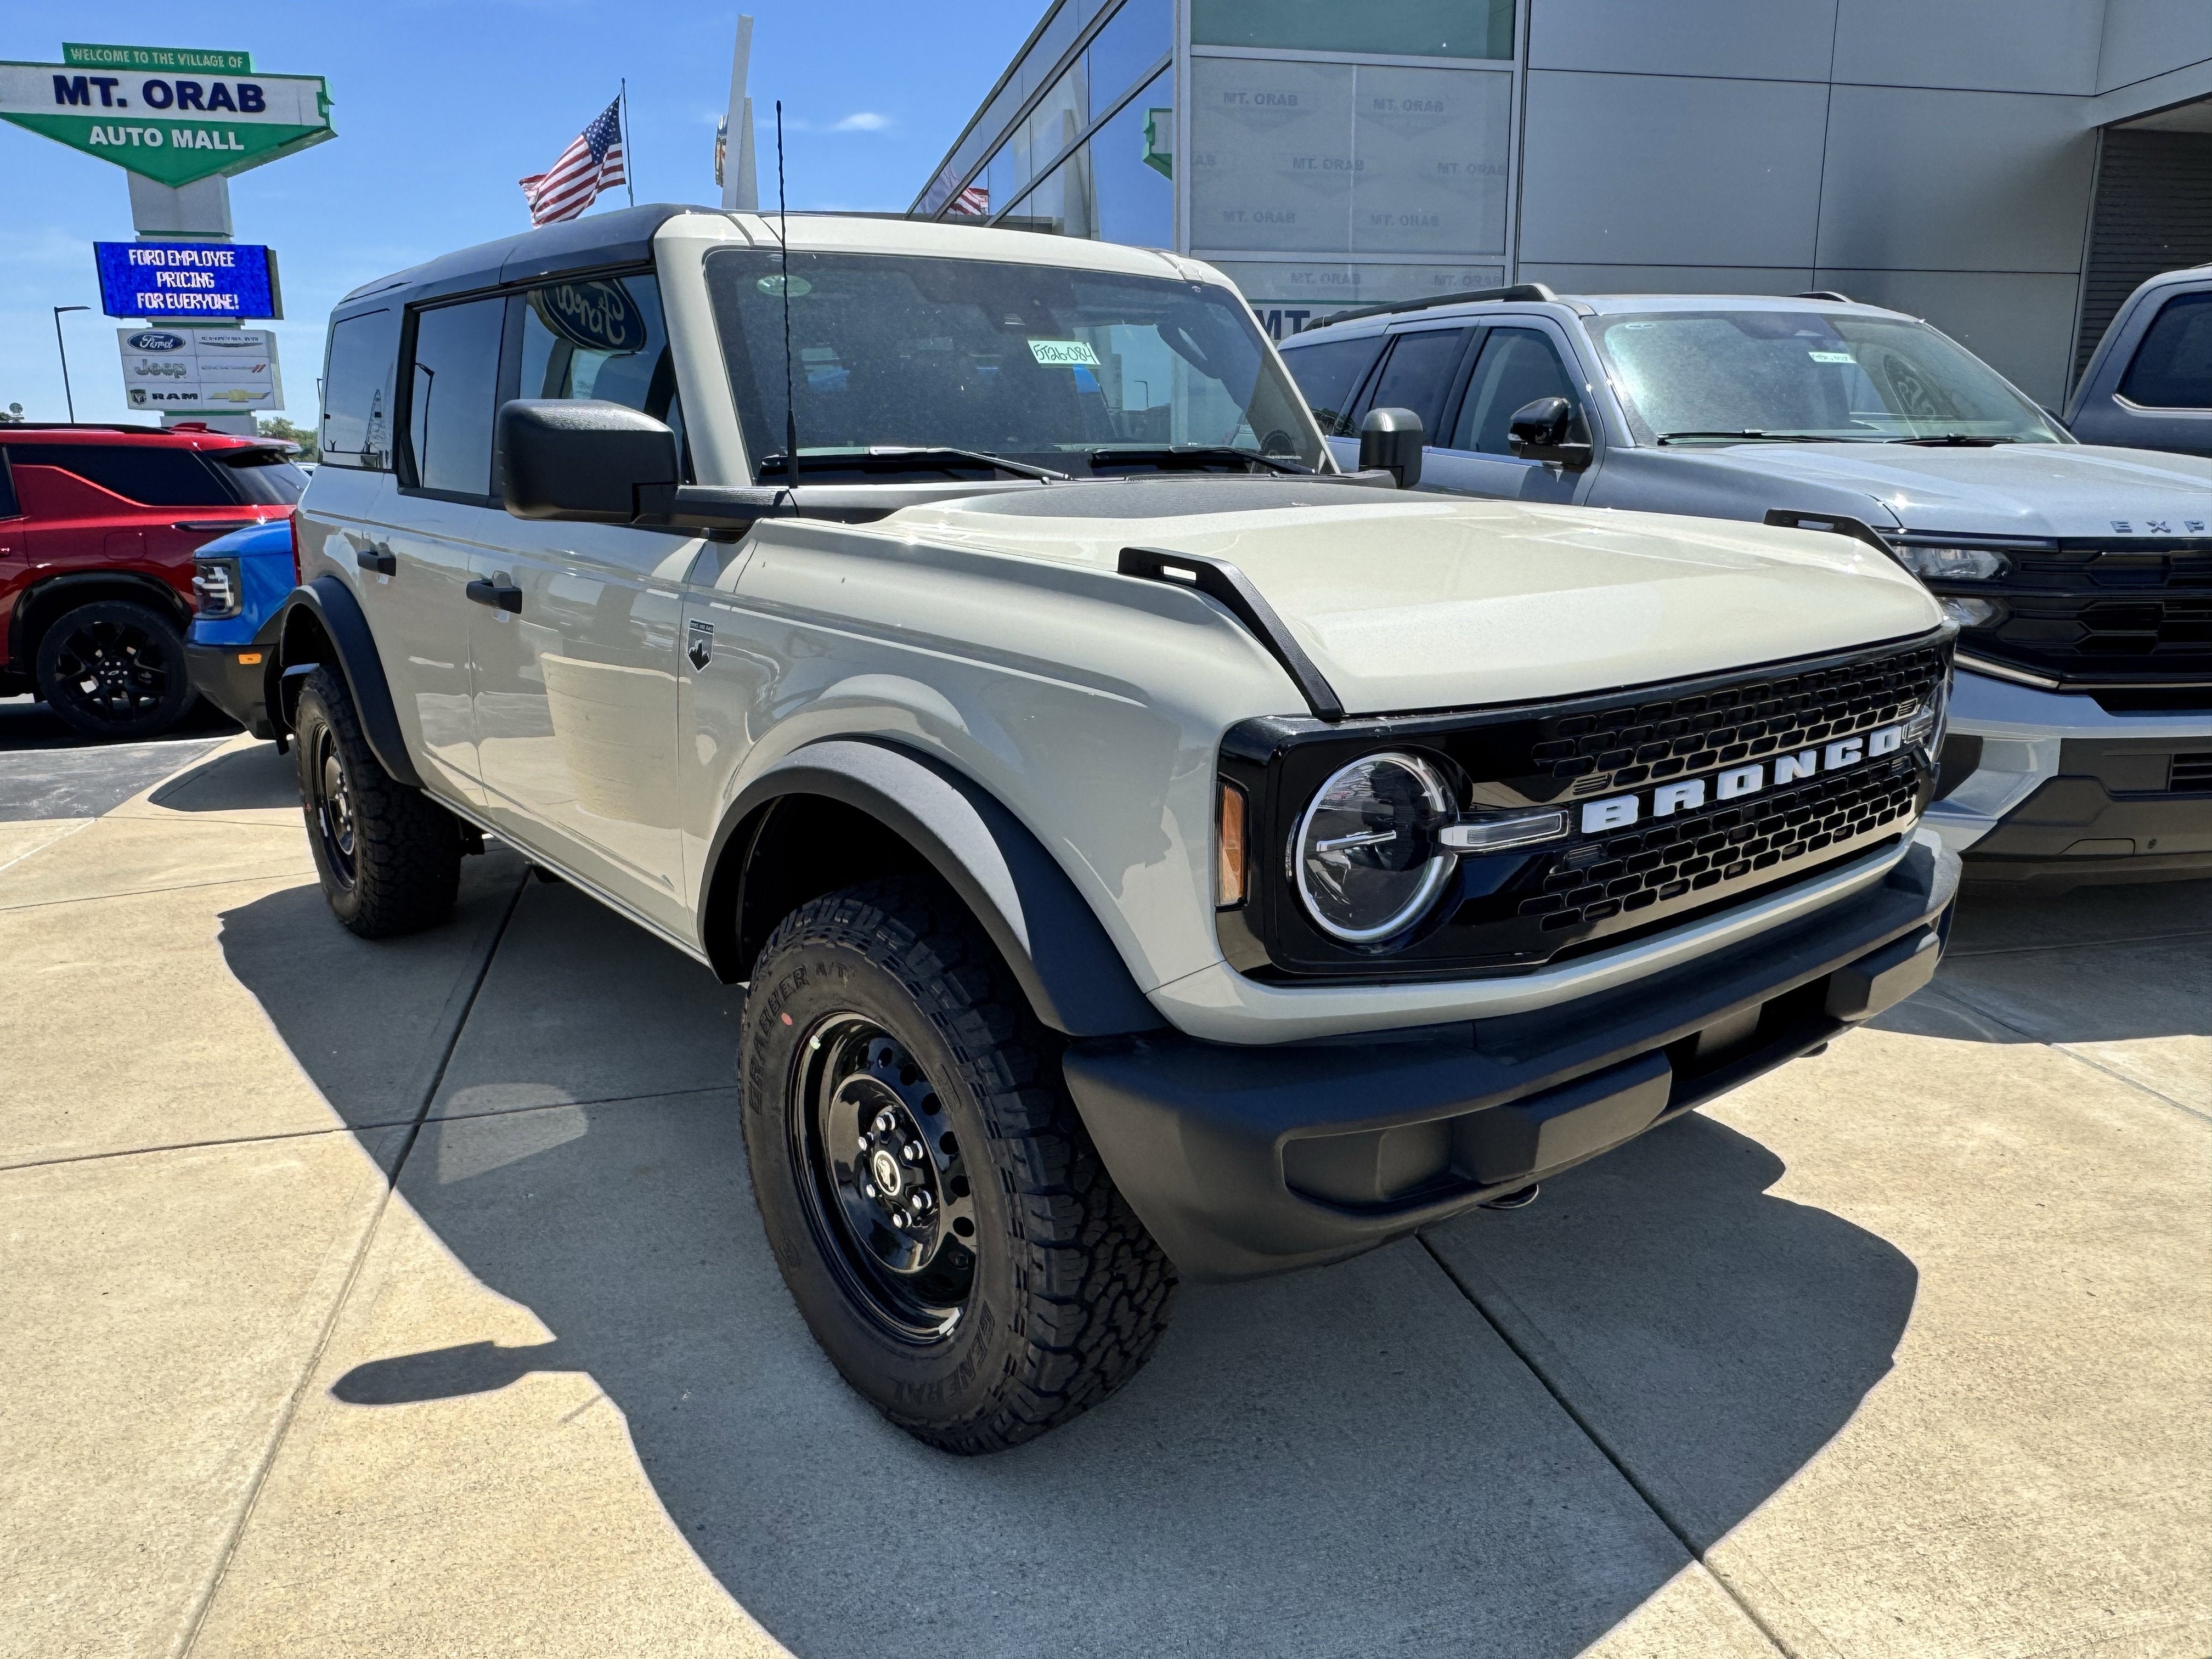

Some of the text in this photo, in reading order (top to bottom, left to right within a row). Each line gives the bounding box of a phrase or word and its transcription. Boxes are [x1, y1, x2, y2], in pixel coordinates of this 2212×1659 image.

[71, 48, 242, 68] WELCOME TO THE VILLAGE OF
[53, 75, 266, 112] MT. ORAB
[89, 126, 245, 150] AUTO MALL
[128, 249, 235, 267] FORD EMPLOYEE
[156, 271, 215, 288] PRICING
[137, 292, 239, 310] FOR EVERYONE!
[139, 335, 173, 348] Ford
[134, 358, 187, 379] Jeep
[1581, 725, 1903, 834] BRONCO
